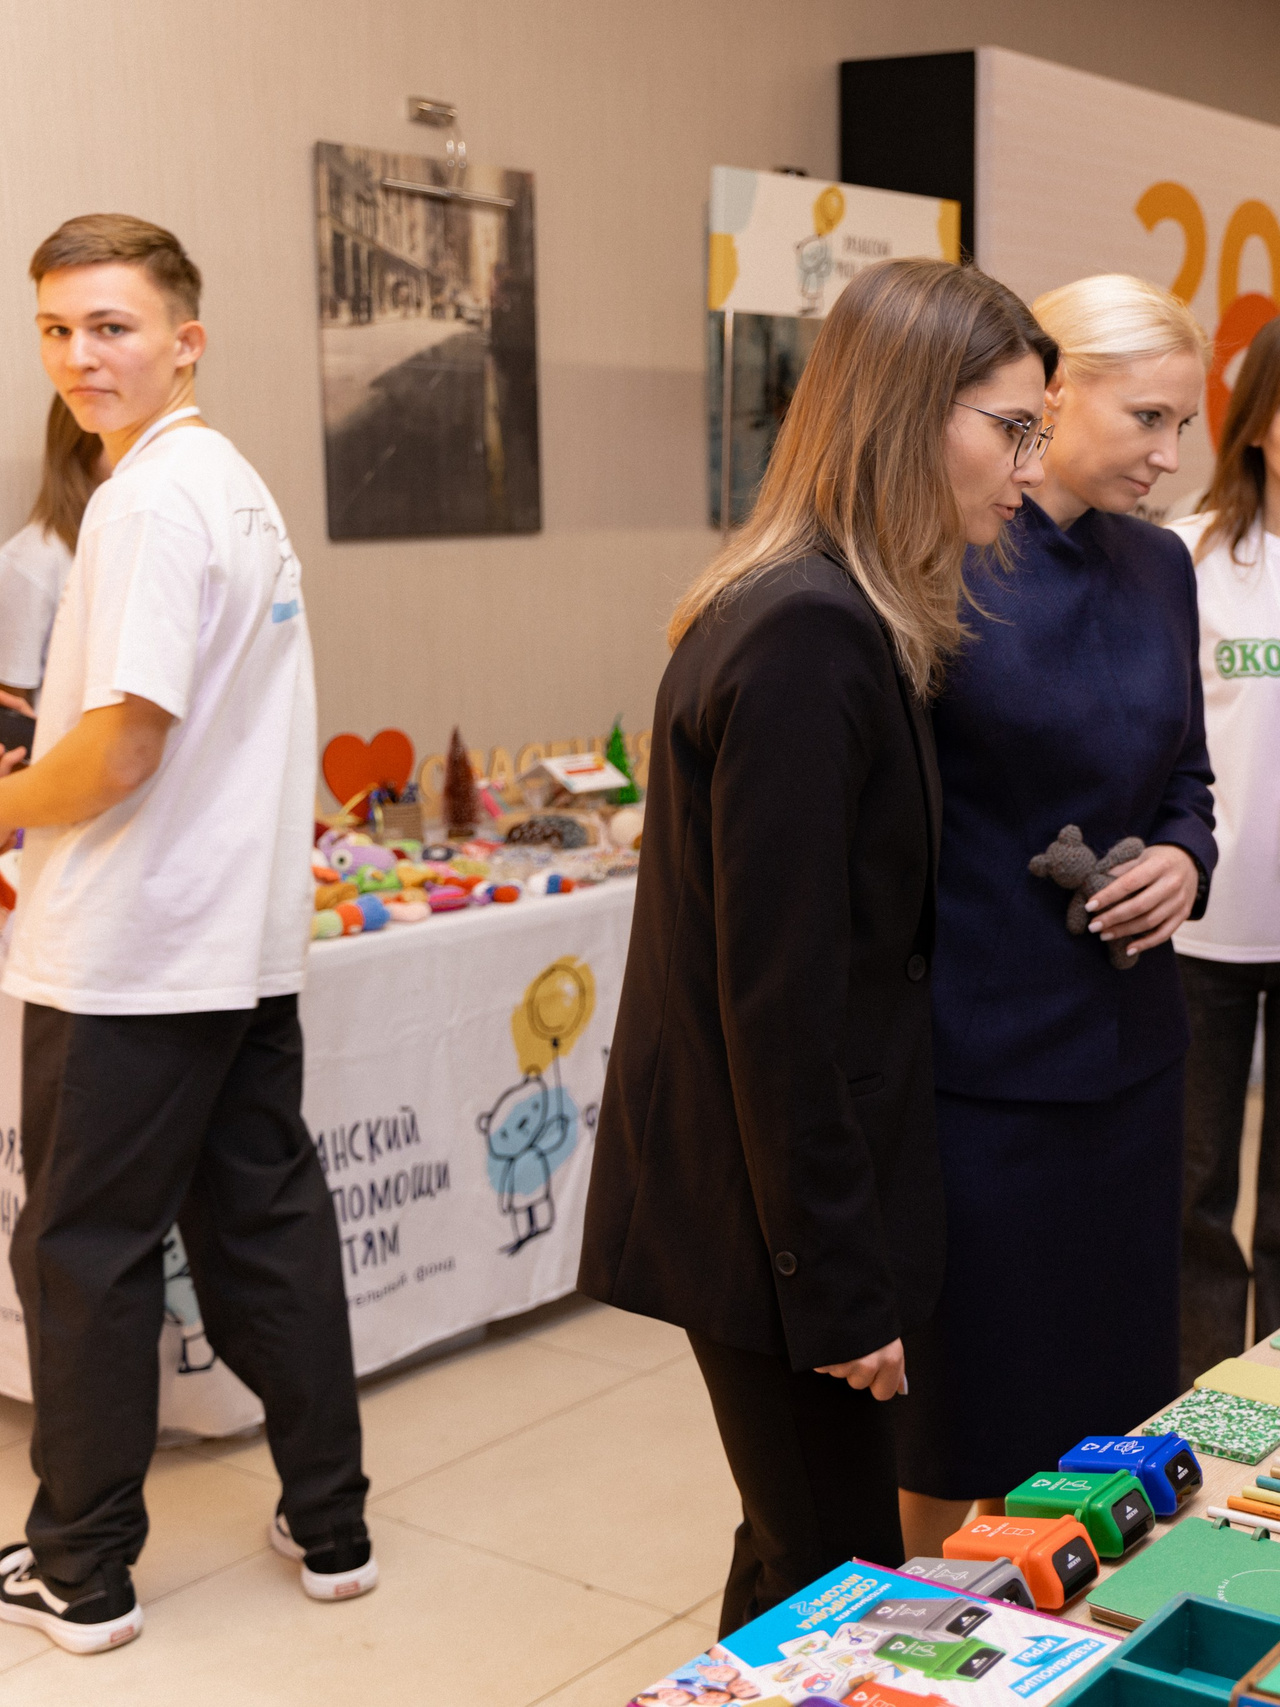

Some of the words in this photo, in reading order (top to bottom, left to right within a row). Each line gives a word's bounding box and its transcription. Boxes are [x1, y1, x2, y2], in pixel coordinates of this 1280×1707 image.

[796, 1578, 878, 1630] СОРТИРОВКА
[809, 1573, 864, 1607] МУСОРА
[789, 1601, 817, 1616] 2
[1018, 1638, 1058, 1662] ИГРЫ
[1014, 1640, 1100, 1695] РАЗВИВАЮЩИЕ
